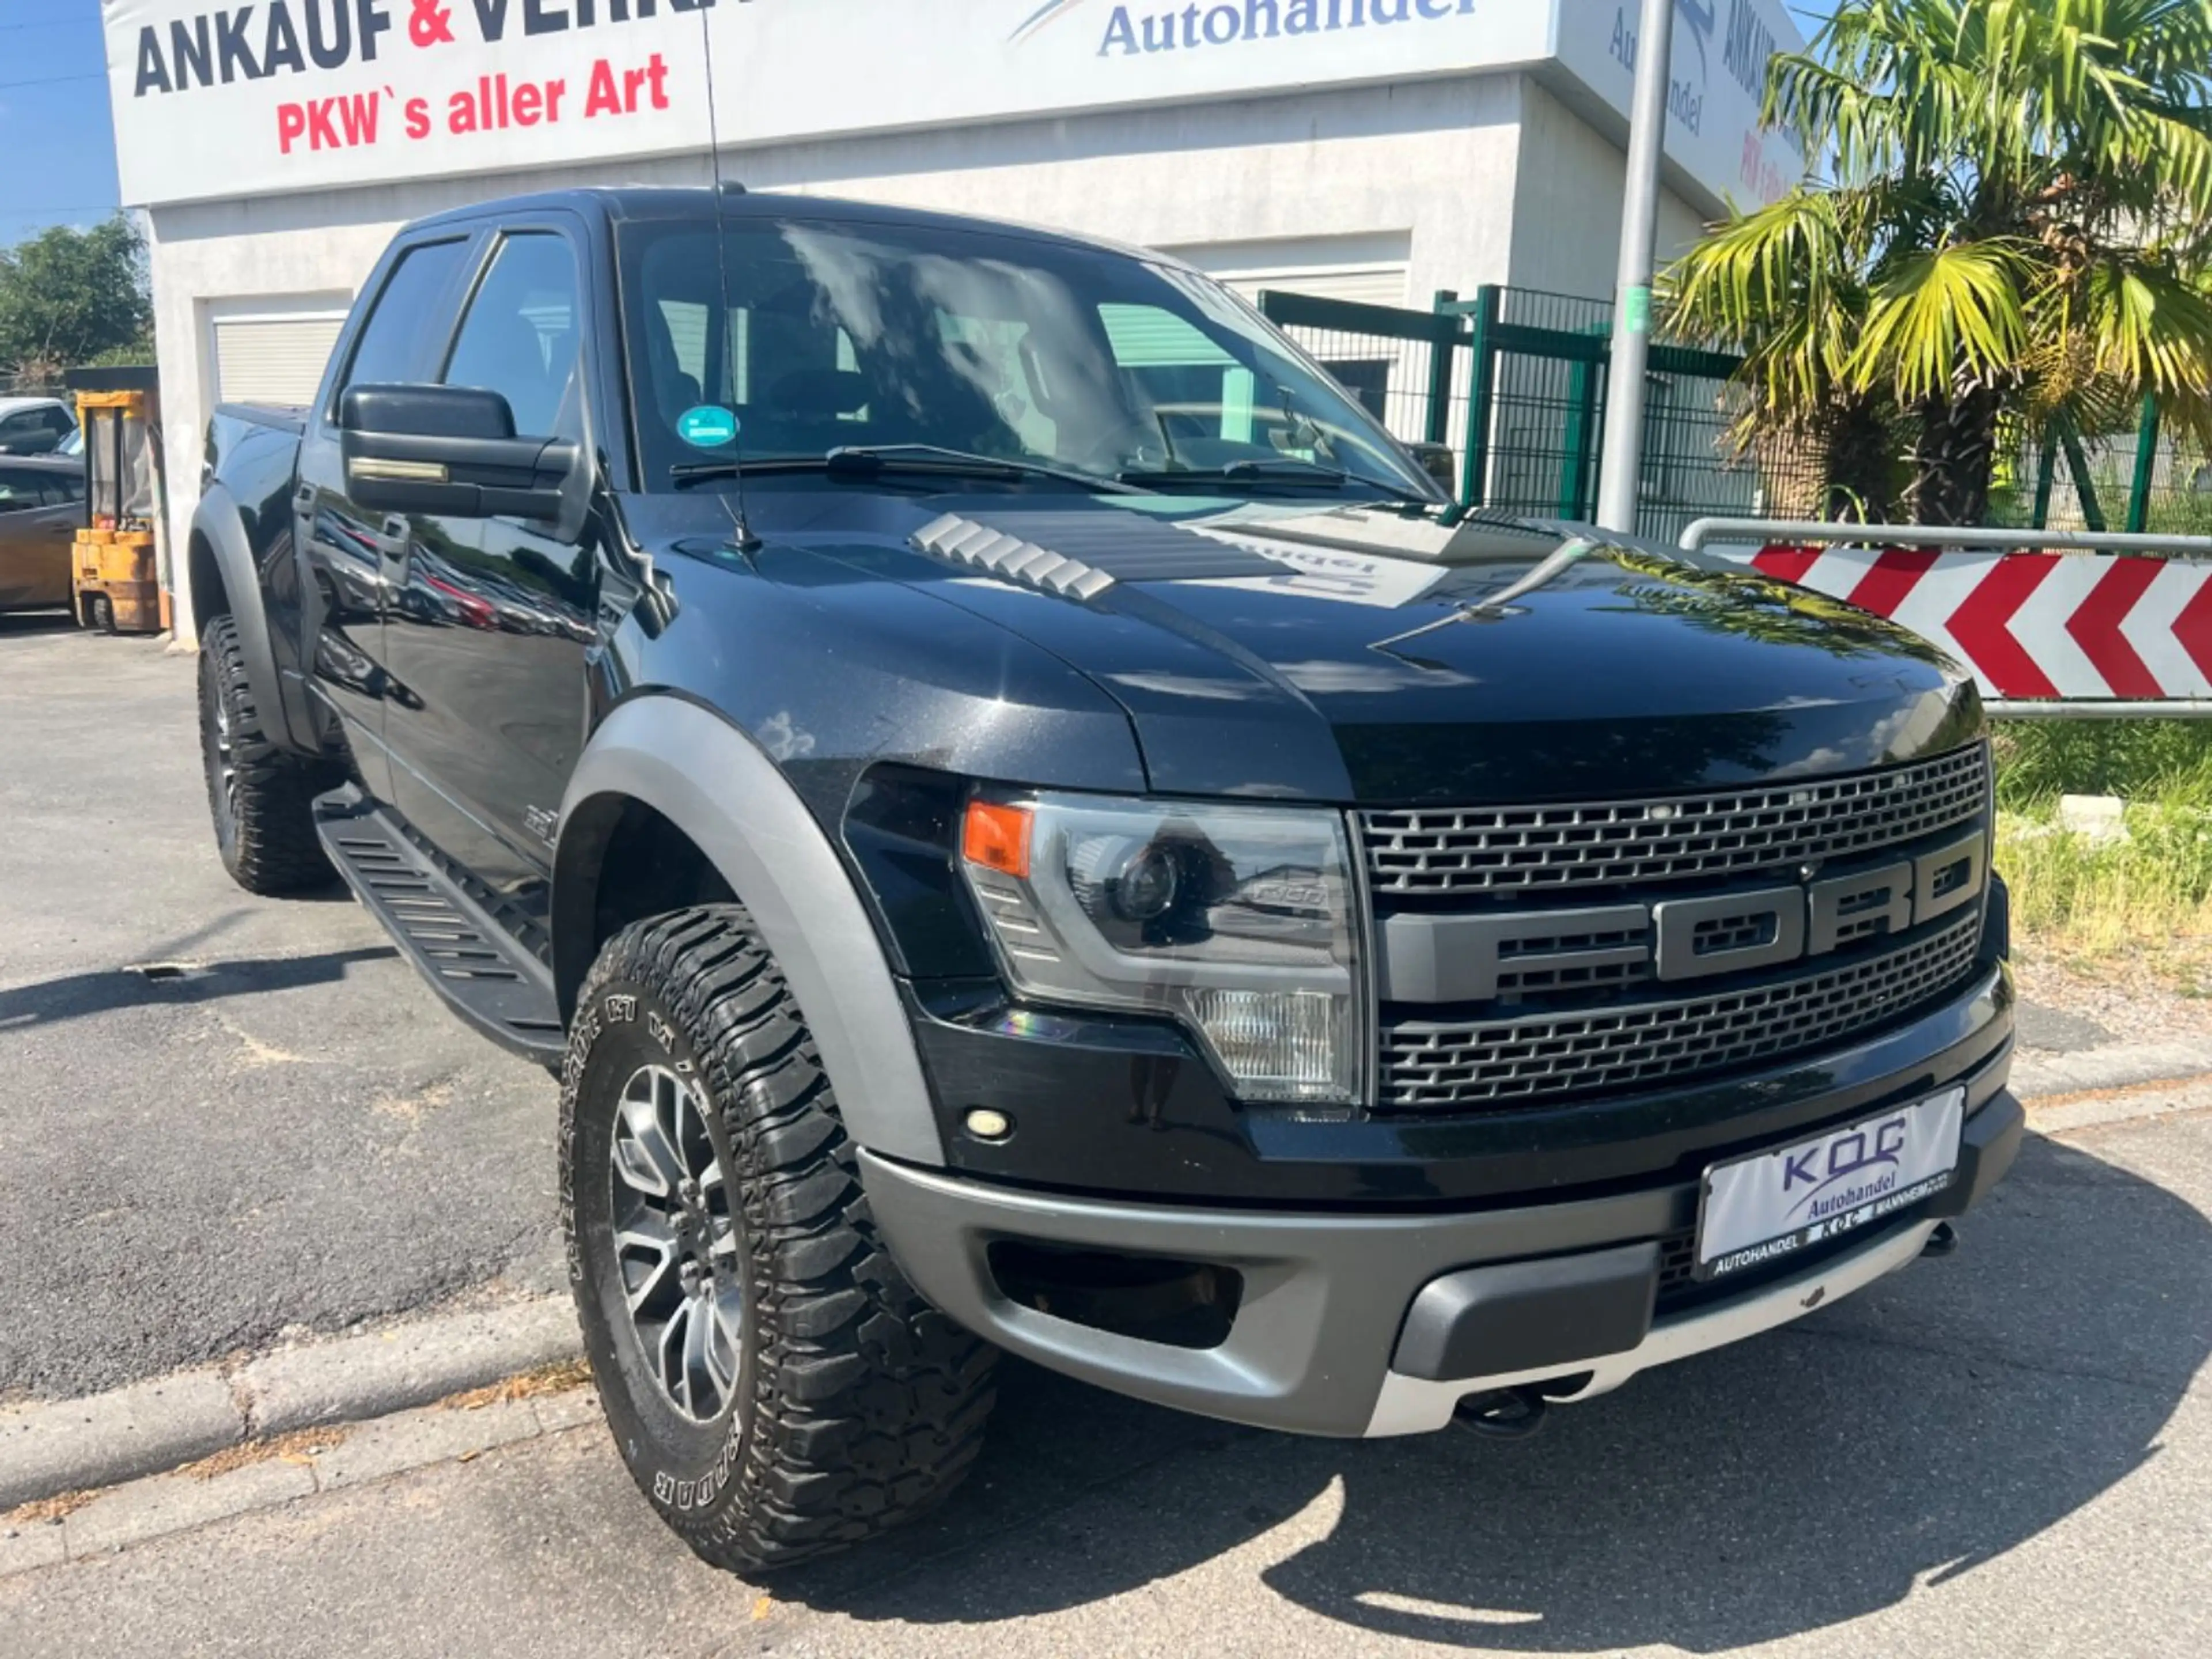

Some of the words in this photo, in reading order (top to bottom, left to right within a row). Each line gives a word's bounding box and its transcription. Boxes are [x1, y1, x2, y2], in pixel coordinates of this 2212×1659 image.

[134, 0, 391, 97] ANKAUF
[408, 0, 455, 47] &
[1096, 0, 1476, 56] Autohan
[448, 73, 565, 134] aller
[585, 54, 669, 118] Art
[1386, 831, 1984, 1002] FORD
[1714, 1234, 1798, 1277] AUTOHANDEL
